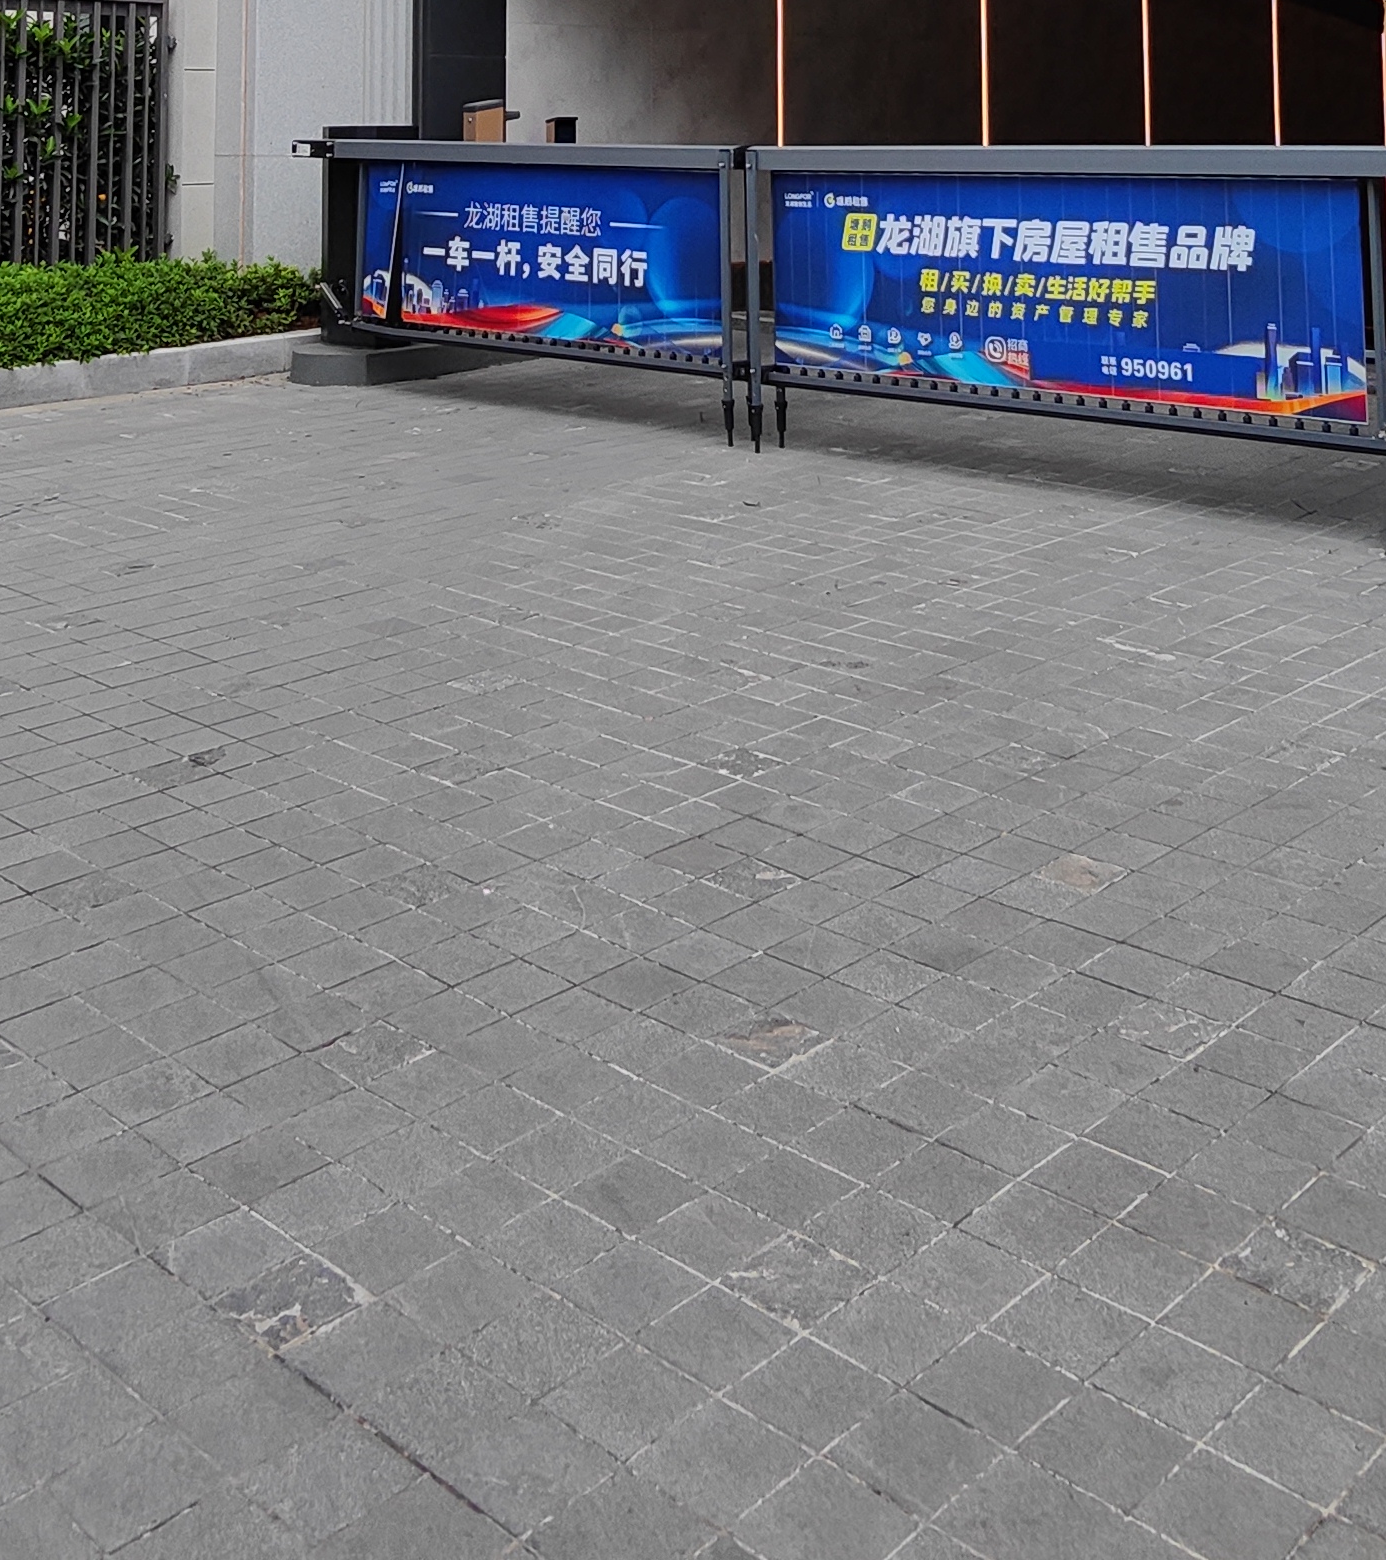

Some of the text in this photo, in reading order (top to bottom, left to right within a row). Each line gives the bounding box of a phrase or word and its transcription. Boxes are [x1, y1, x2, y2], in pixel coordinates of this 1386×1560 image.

[463, 200, 602, 237] 龙湖租售提醒您
[876, 214, 1256, 272] 龙湖旗下房屋租售品牌
[919, 268, 1156, 305] 租/买/换/卖/生活好帮手
[920, 296, 1149, 328] 您身边的资产管理专家
[1120, 357, 1193, 382] 950961
